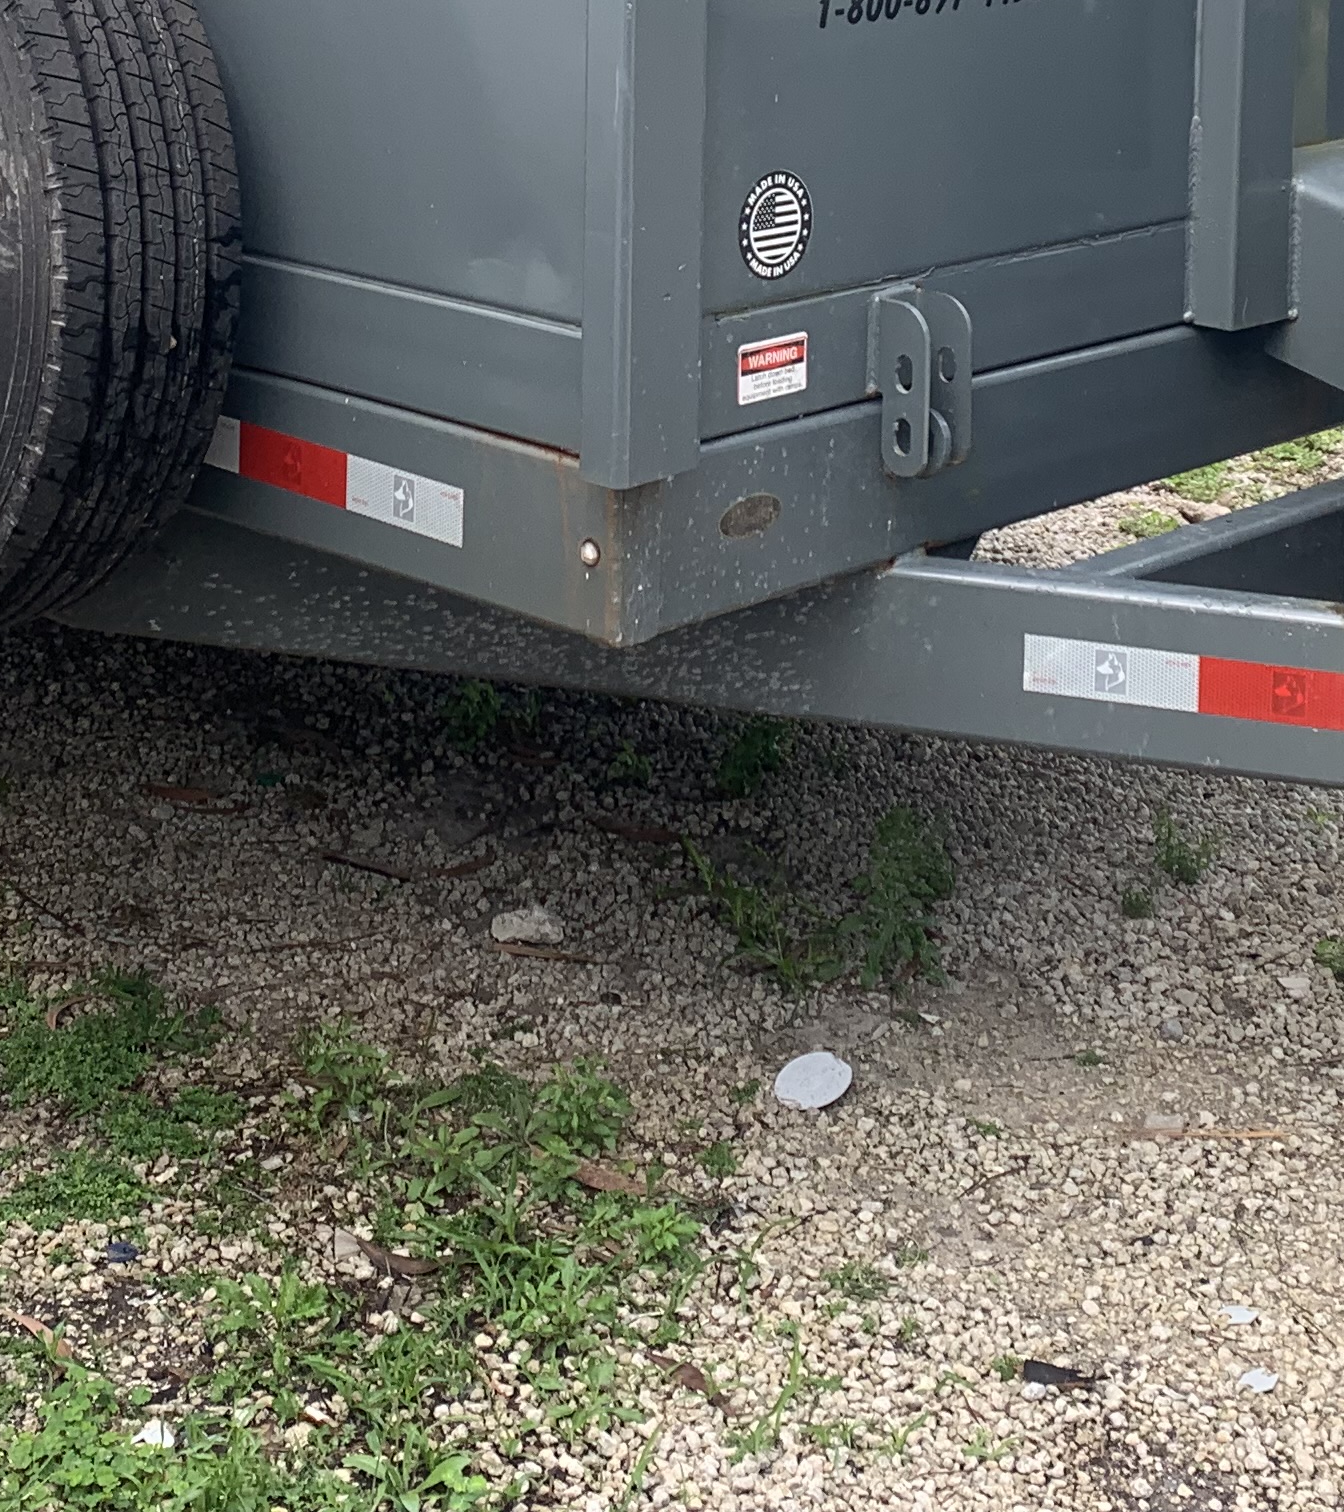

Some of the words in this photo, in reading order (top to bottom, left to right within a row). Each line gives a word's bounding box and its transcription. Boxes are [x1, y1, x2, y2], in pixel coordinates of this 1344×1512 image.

[747, 175, 774, 207] MADE
[775, 174, 787, 185] IN
[787, 176, 805, 199] USA
[748, 258, 773, 278] MADE
[772, 265, 784, 278] IN
[783, 251, 802, 272] USA
[748, 346, 798, 368] WARNING
